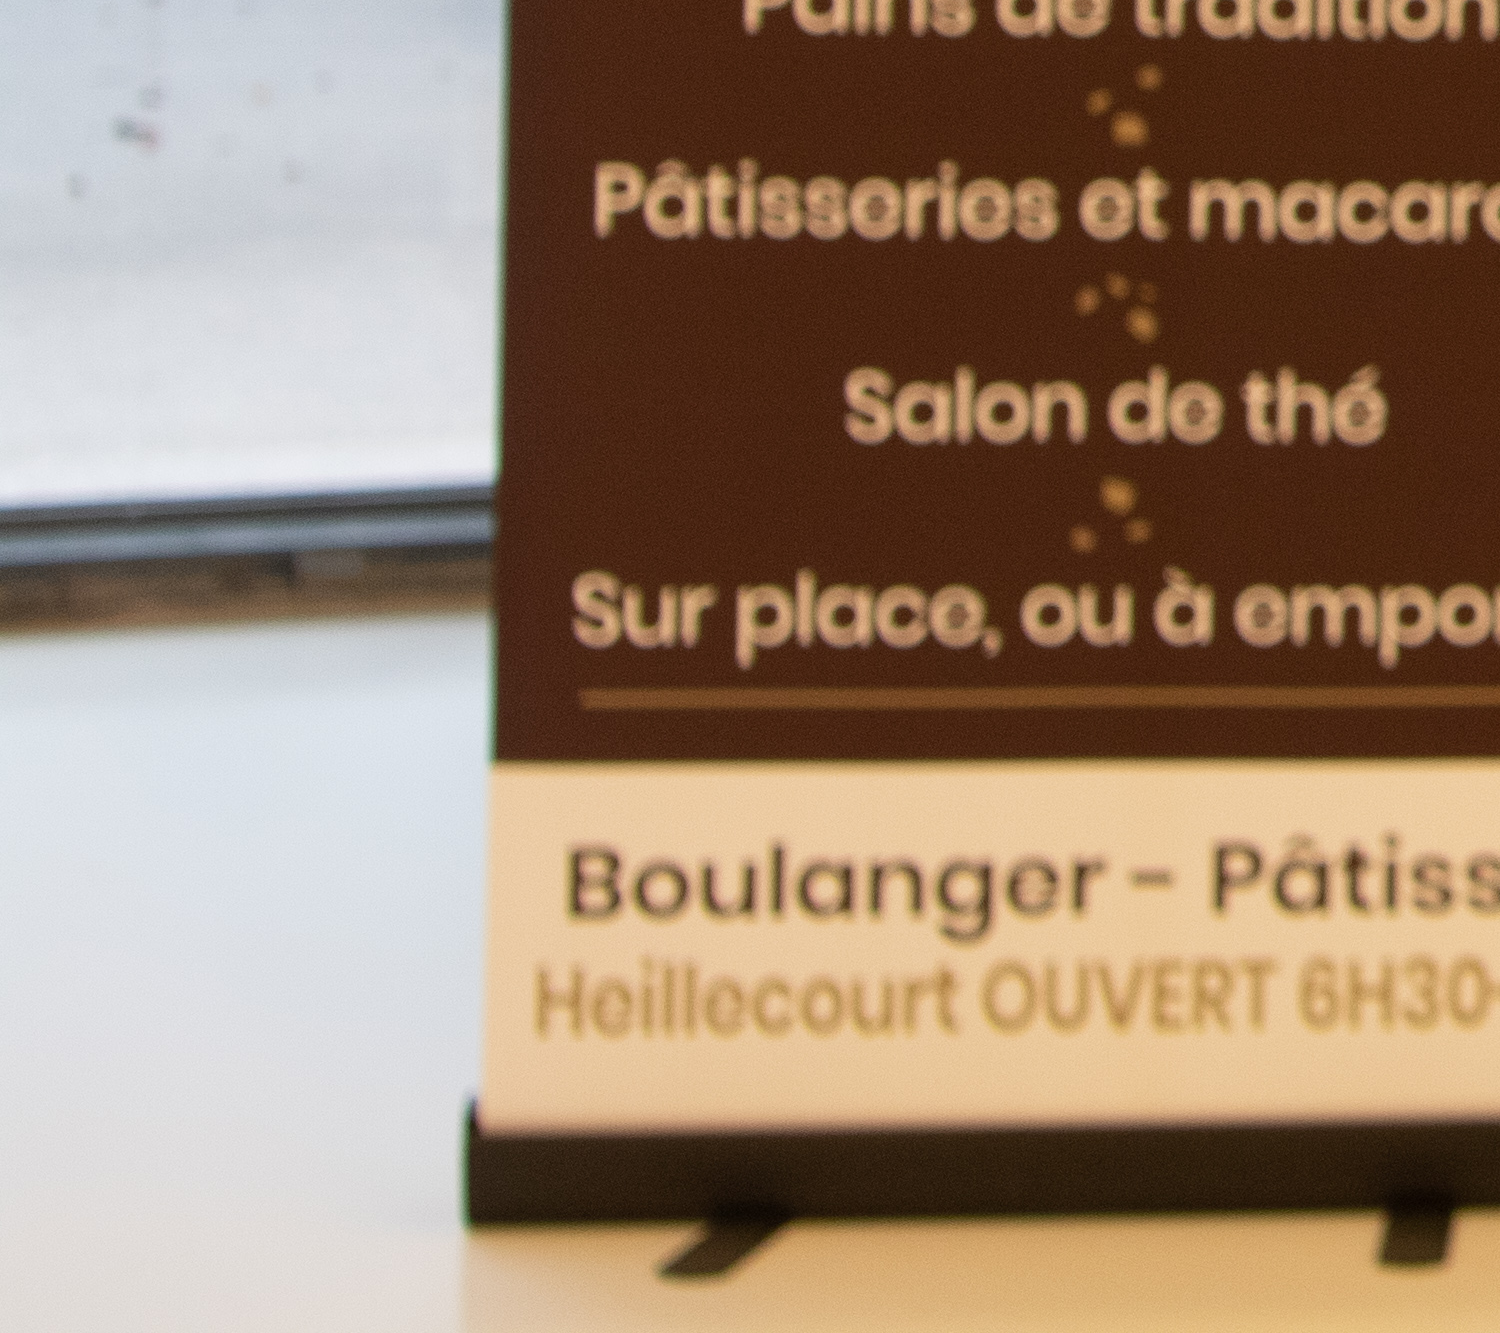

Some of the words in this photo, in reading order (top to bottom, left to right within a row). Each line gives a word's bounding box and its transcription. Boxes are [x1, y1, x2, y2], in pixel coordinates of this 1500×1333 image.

[592, 157, 1061, 242] Pâtisseries
[1077, 167, 1169, 242] et
[843, 366, 1088, 445] Salon
[1107, 367, 1224, 444] de
[1243, 365, 1388, 445] thé
[570, 569, 716, 650] Sur
[733, 569, 1003, 671] place,
[1018, 583, 1134, 648] ou
[1152, 568, 1215, 647] à
[566, 842, 1106, 945] Boulanger
[530, 953, 960, 1041] Heillecourt
[981, 957, 1278, 1036] OUVERT
